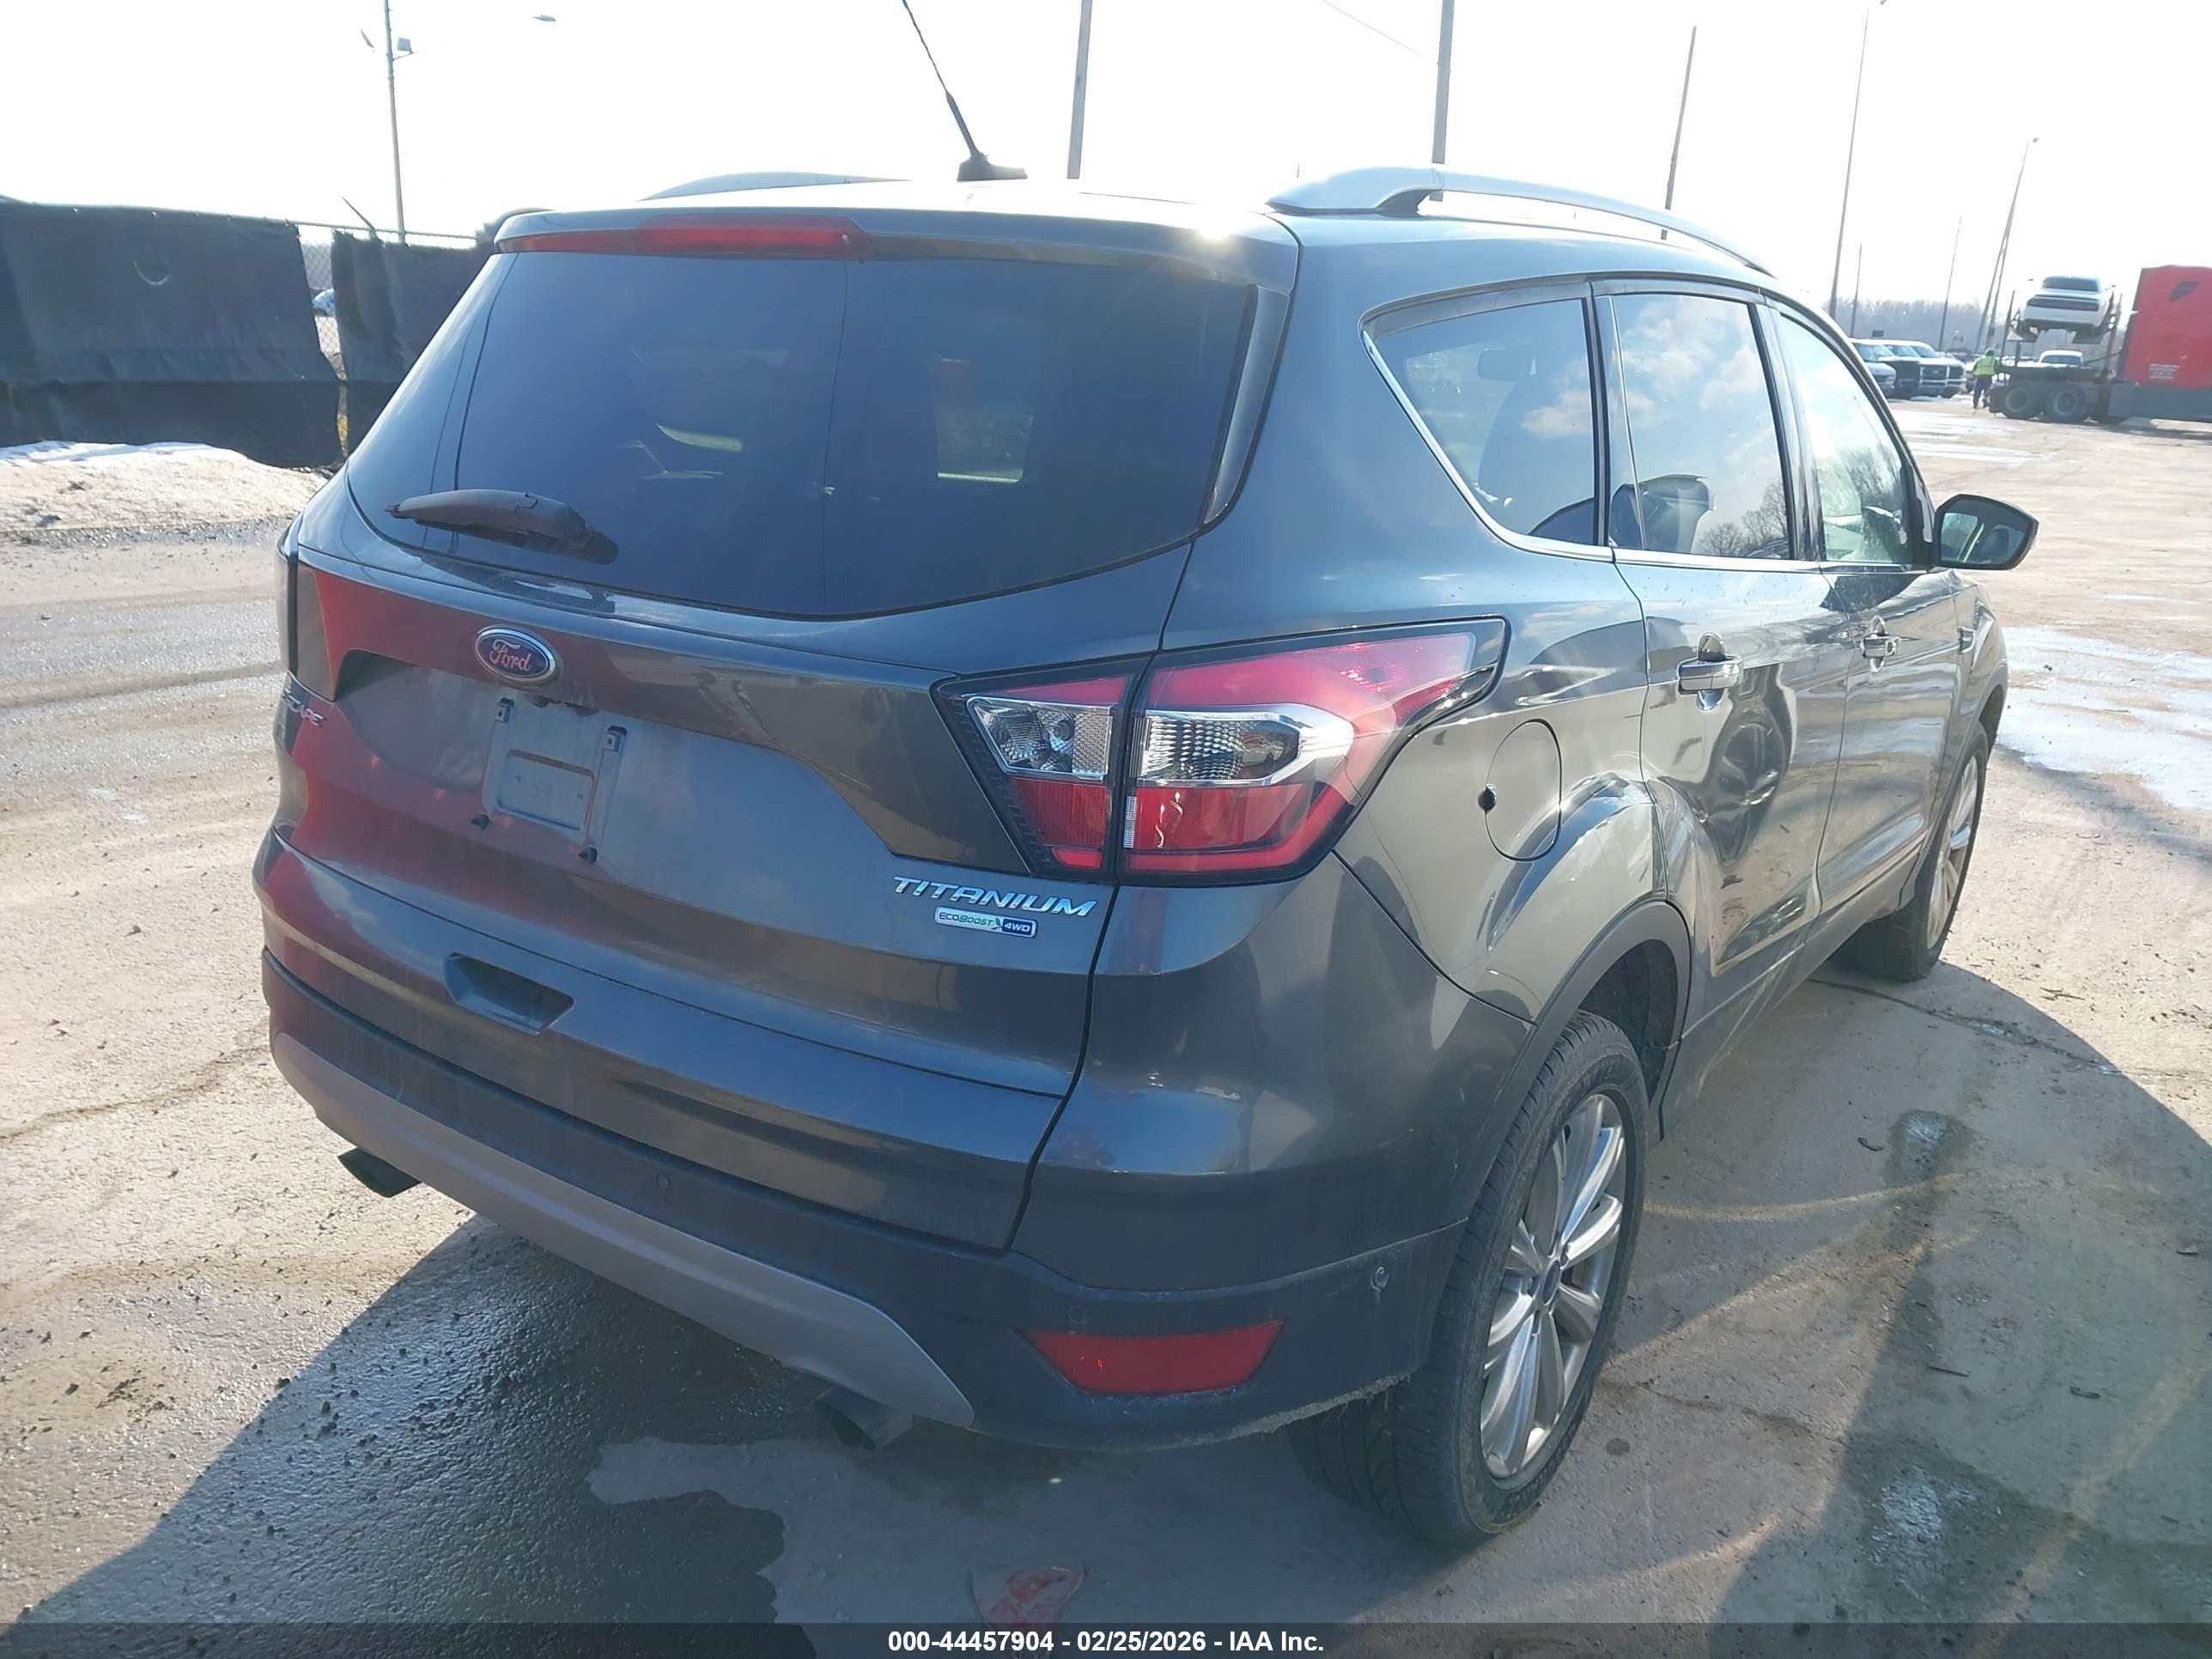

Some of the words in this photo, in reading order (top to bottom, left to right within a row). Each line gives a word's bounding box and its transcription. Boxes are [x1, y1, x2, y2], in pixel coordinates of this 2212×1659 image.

[489, 639, 532, 672] Ford
[892, 875, 1098, 917] TITANIUM
[939, 911, 995, 927] ECOBOOST
[1003, 921, 1032, 933] 4WD
